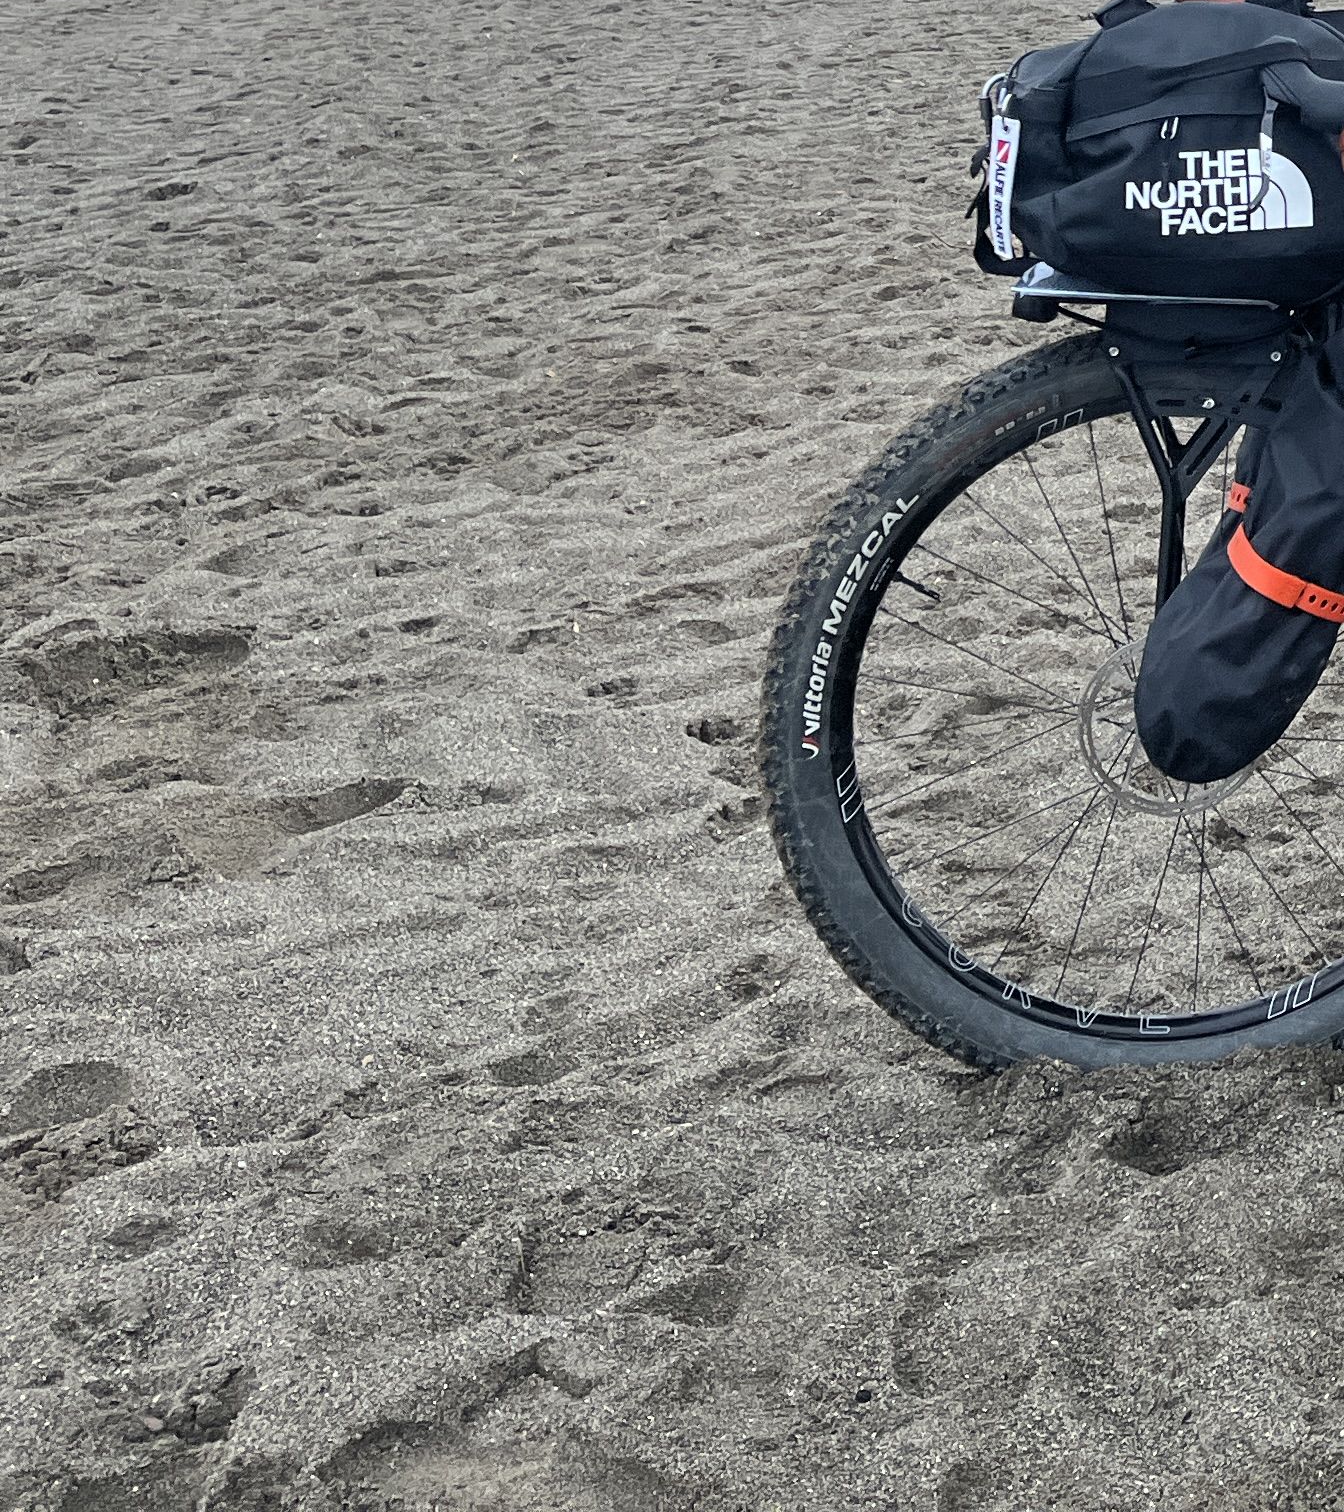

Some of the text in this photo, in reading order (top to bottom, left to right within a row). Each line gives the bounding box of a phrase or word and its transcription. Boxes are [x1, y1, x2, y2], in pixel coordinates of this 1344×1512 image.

[1178, 149, 1247, 179] THE
[1125, 177, 1249, 210] NORTH
[1161, 205, 1249, 236] FACE
[822, 494, 920, 636] MEZCAL
